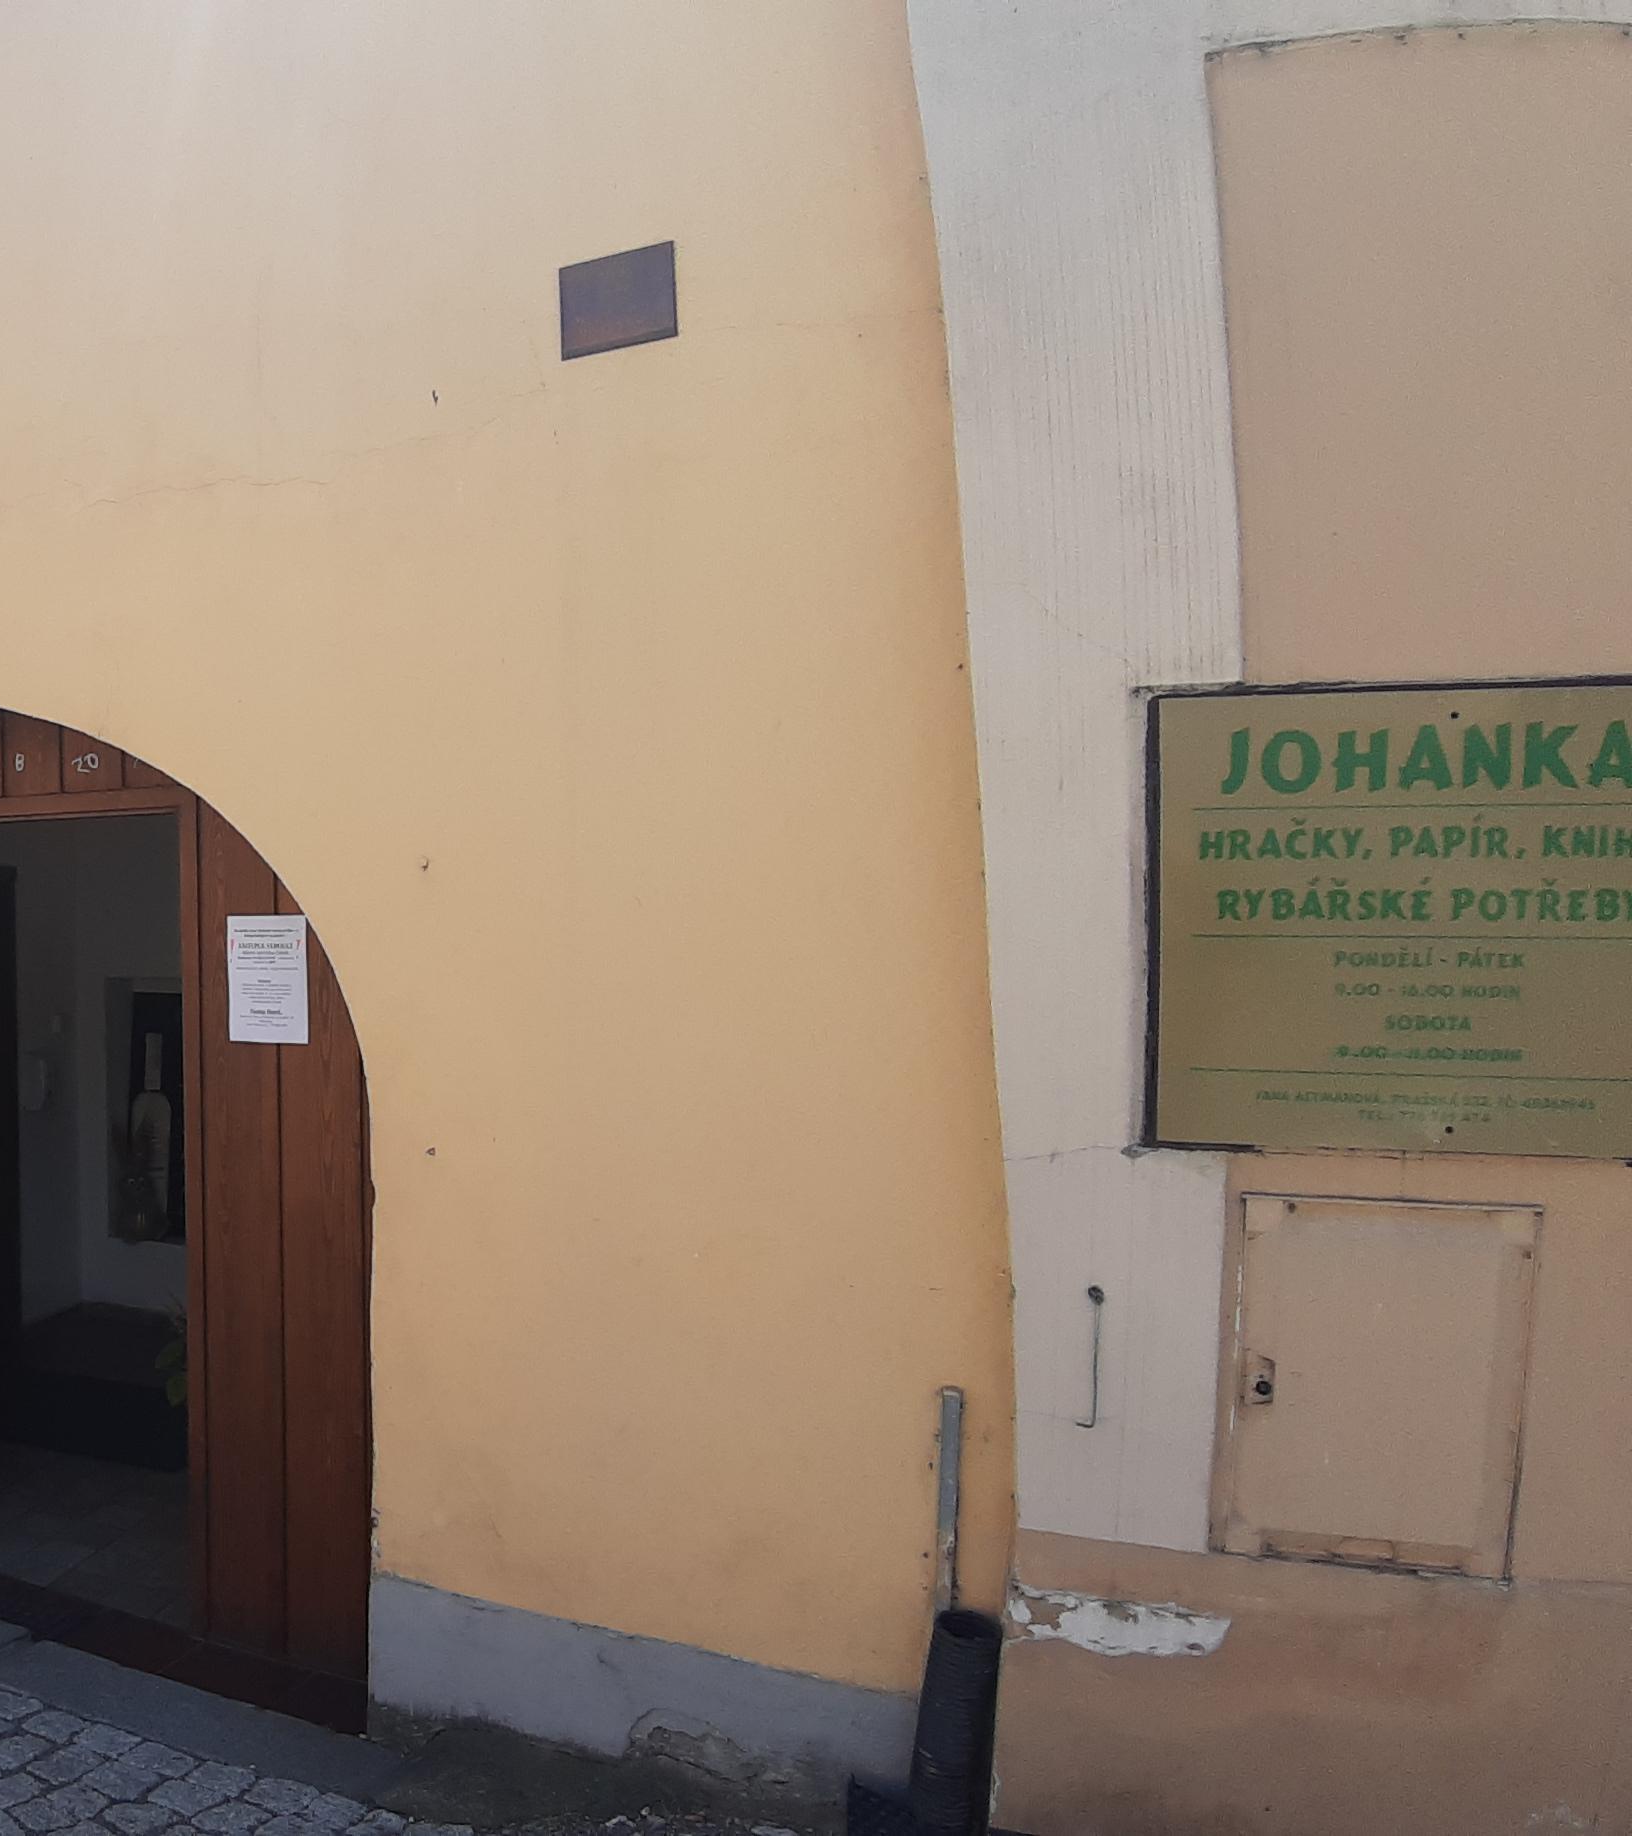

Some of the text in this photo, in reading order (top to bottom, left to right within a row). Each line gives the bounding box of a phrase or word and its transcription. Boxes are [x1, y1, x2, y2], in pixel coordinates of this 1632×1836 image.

[15, 753, 25, 772] B
[71, 753, 100, 773] 20
[1220, 720, 1632, 795] JOHANKA
[1199, 817, 1374, 861] HRAČKY,
[1390, 815, 1527, 859] PAPÍR,
[1216, 876, 1434, 922] RYBÁŘSKÉ
[1334, 946, 1433, 967] PONDĚLÍ
[1457, 946, 1524, 968] PÁTEK
[1462, 984, 1520, 998] HODIN
[1384, 1015, 1472, 1031] SOBOTA
